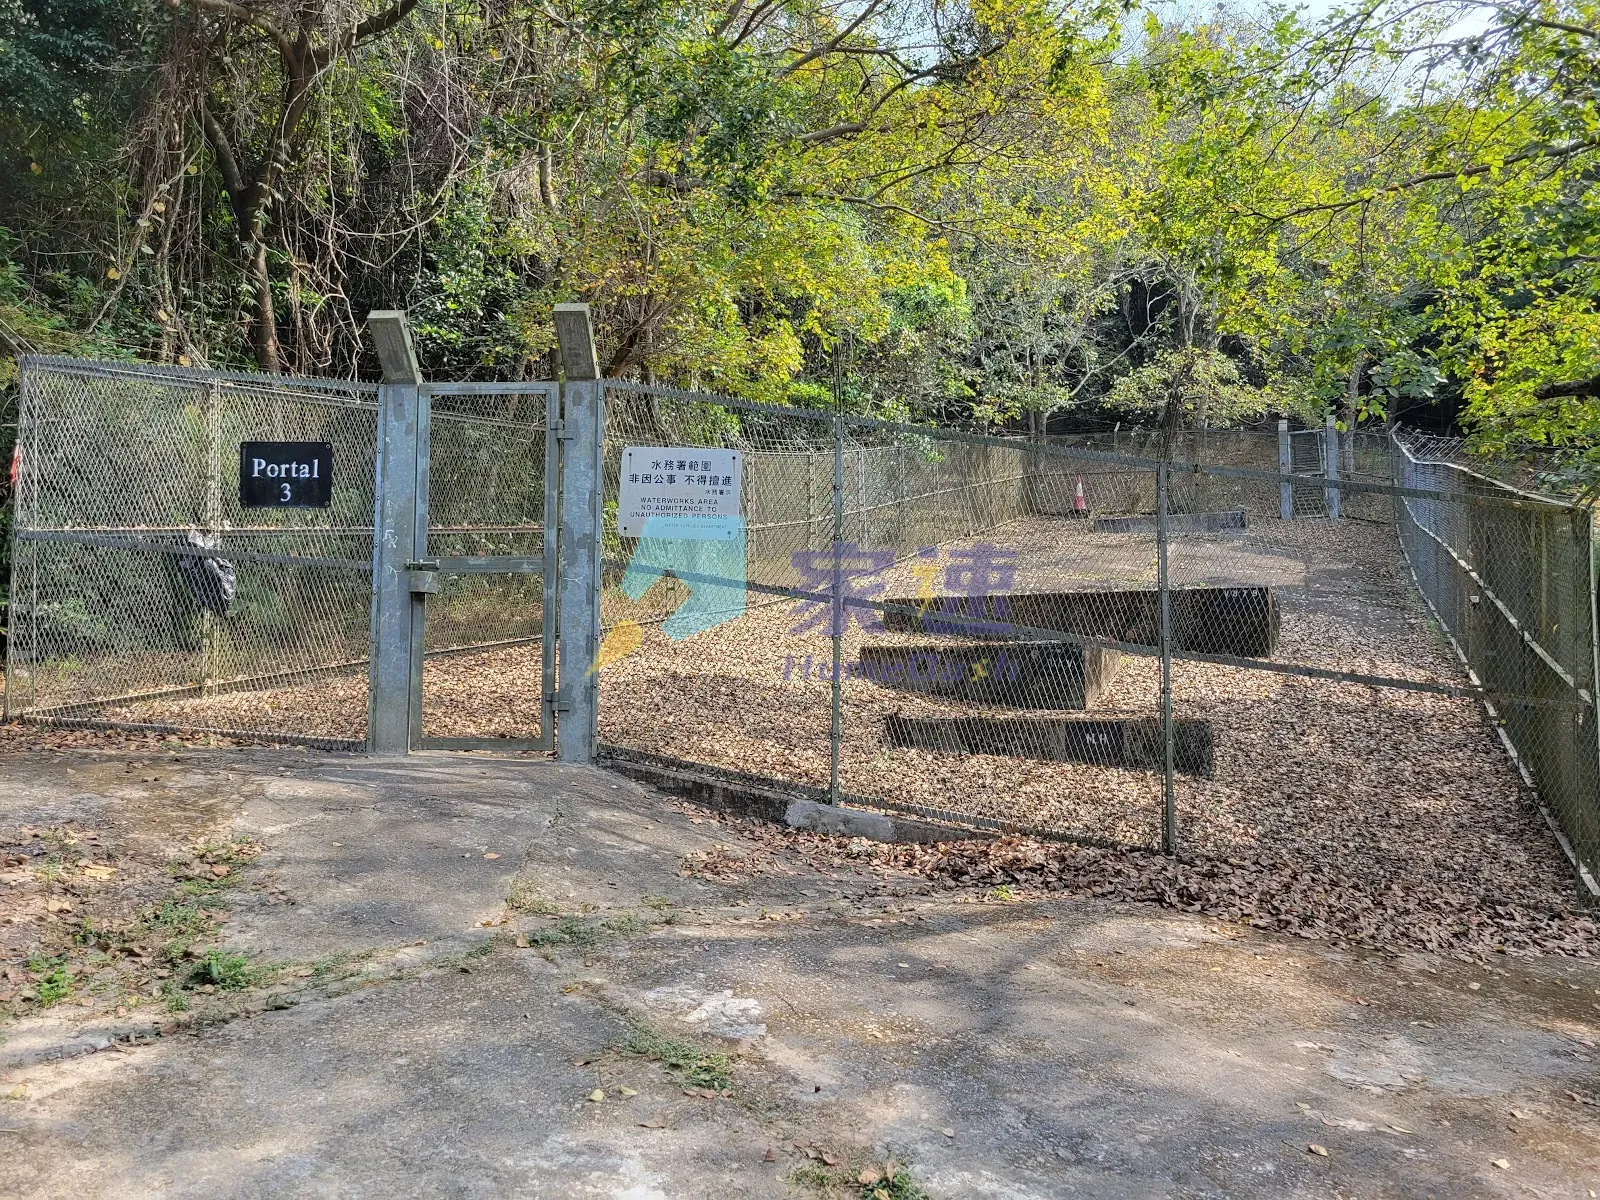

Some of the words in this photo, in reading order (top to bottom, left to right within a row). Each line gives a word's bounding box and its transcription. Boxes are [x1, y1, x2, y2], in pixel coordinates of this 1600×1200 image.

[251, 458, 319, 478] Portal
[651, 460, 712, 472] 水務署範圍
[629, 473, 677, 485] 非因公事
[684, 474, 732, 487] 不得擅進
[280, 482, 292, 502] 3
[640, 497, 694, 505] WATERWORKS
[630, 511, 689, 519] UNAUTHORIZED
